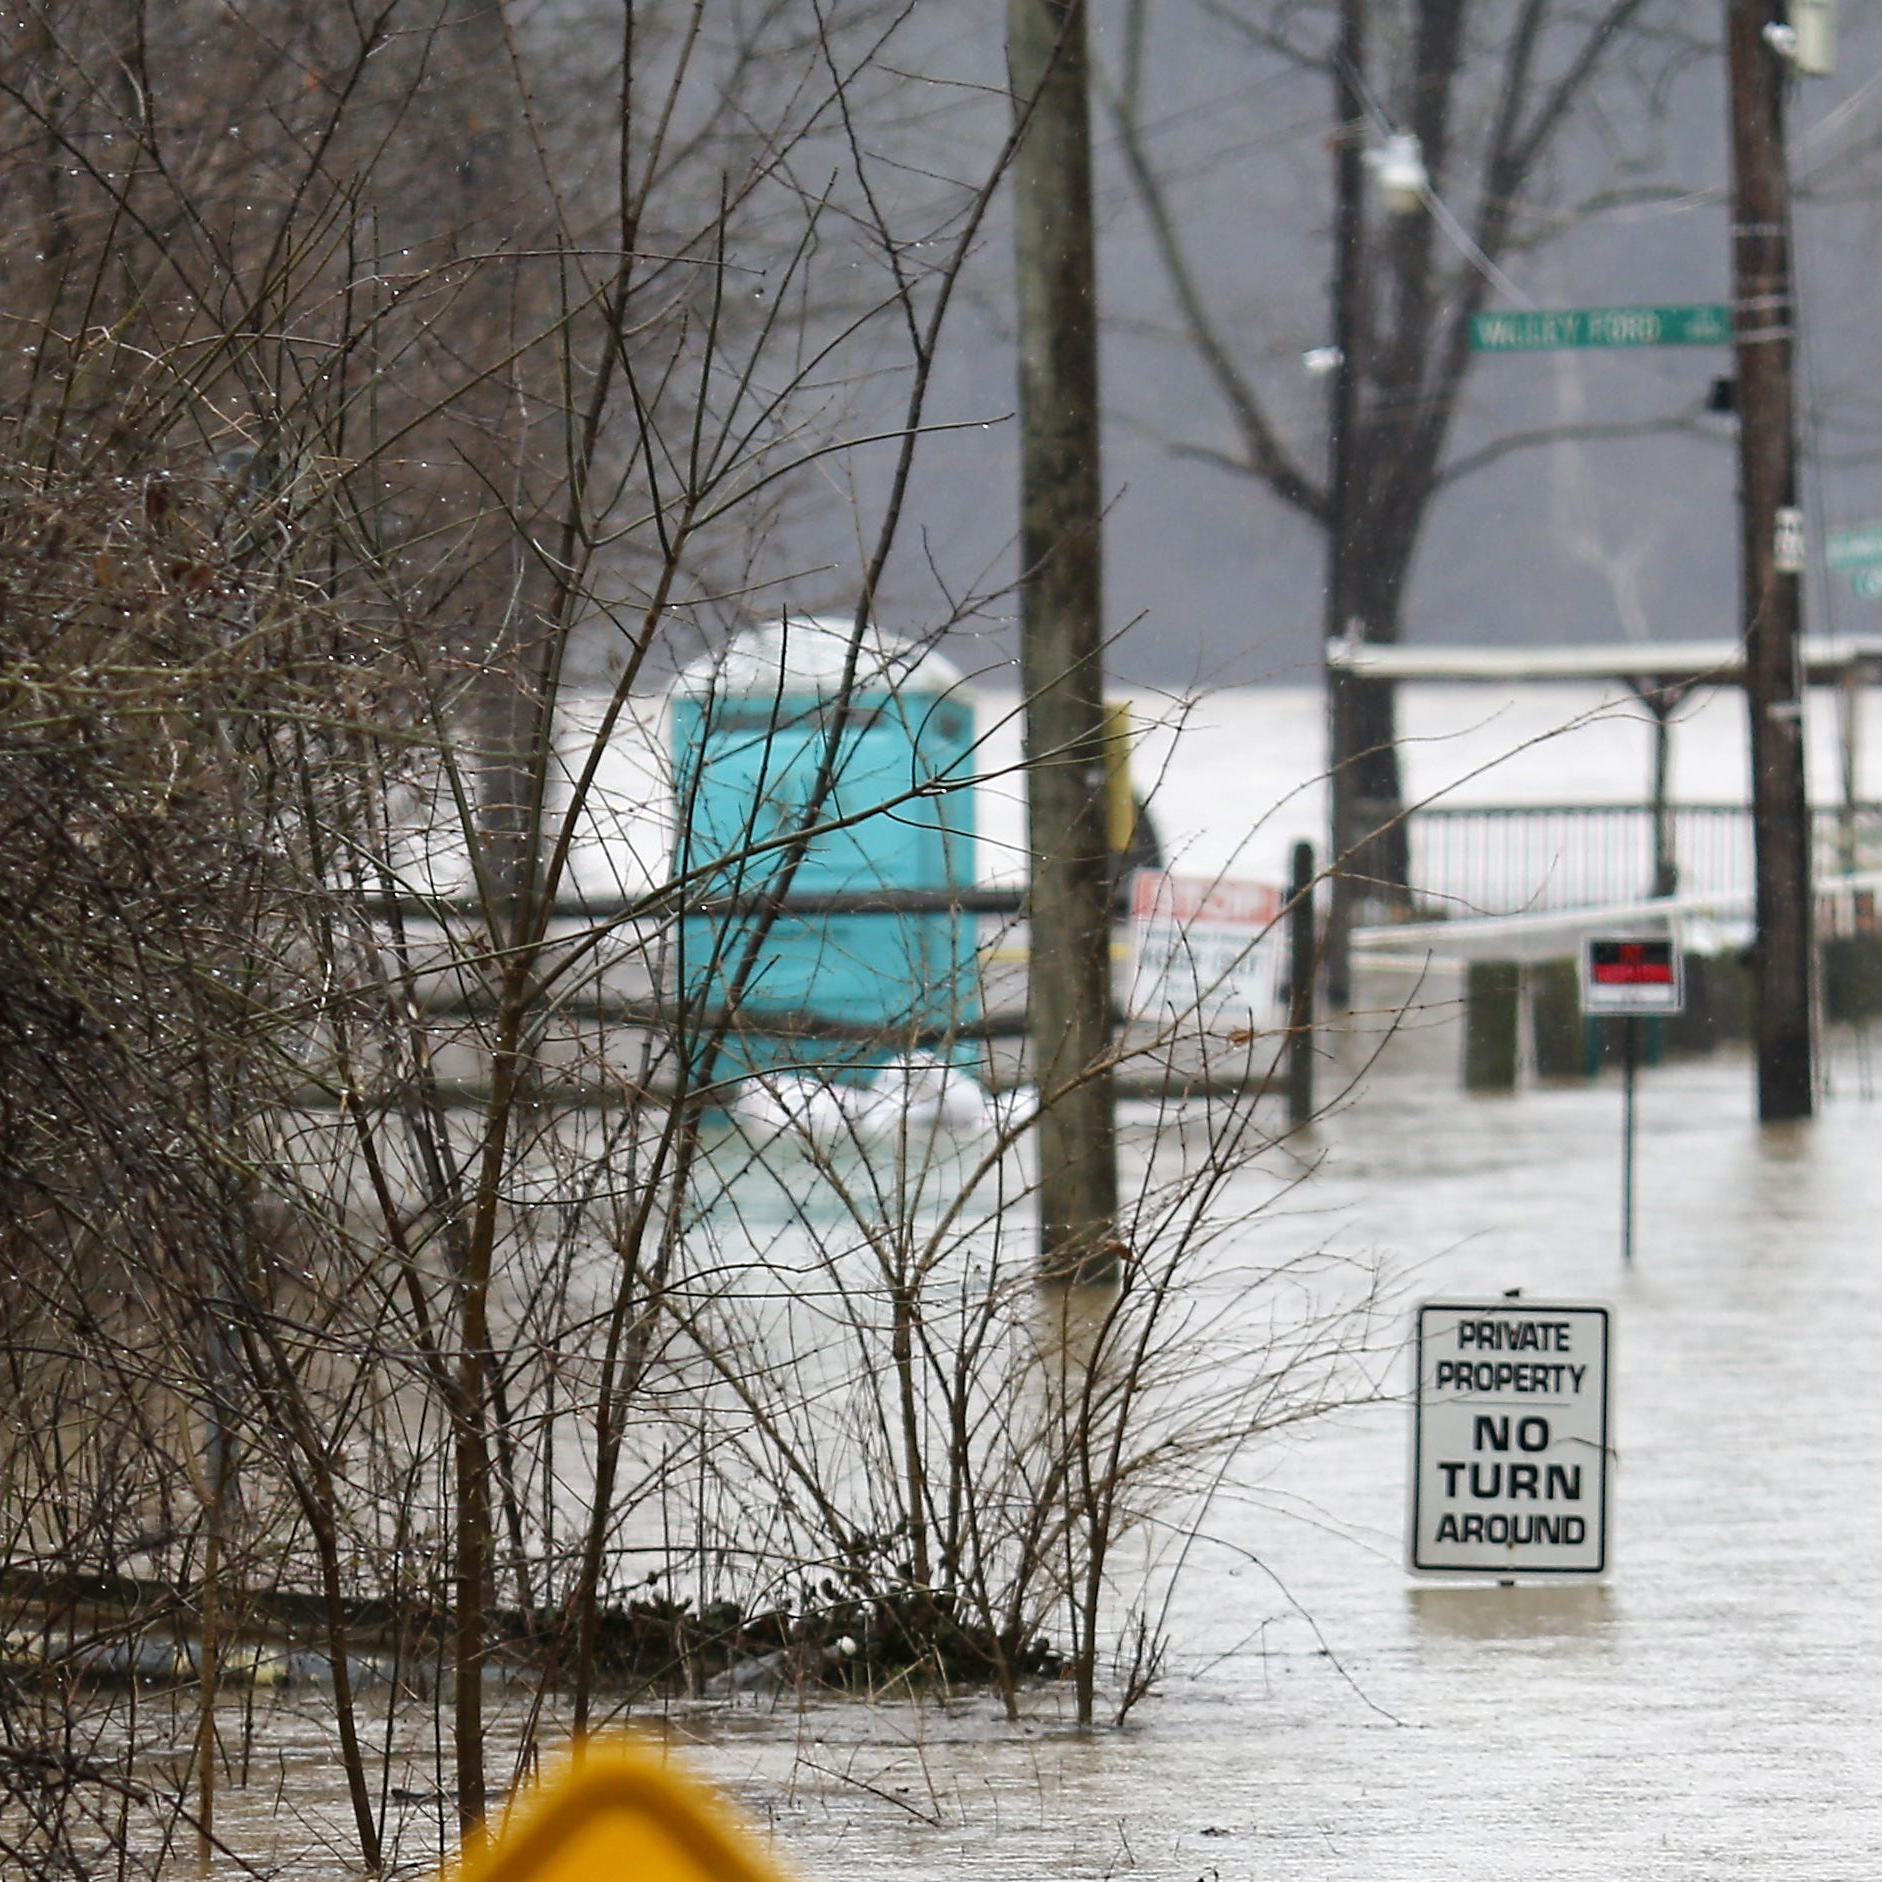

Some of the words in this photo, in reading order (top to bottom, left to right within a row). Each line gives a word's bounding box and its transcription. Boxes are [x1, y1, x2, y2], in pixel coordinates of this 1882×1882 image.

[1458, 1320, 1571, 1352] PRIVATE
[1436, 1360, 1587, 1394] PROPERTY
[1474, 1415, 1550, 1452] NO
[1437, 1462, 1582, 1501] TURN
[1435, 1513, 1586, 1545] AROUND
